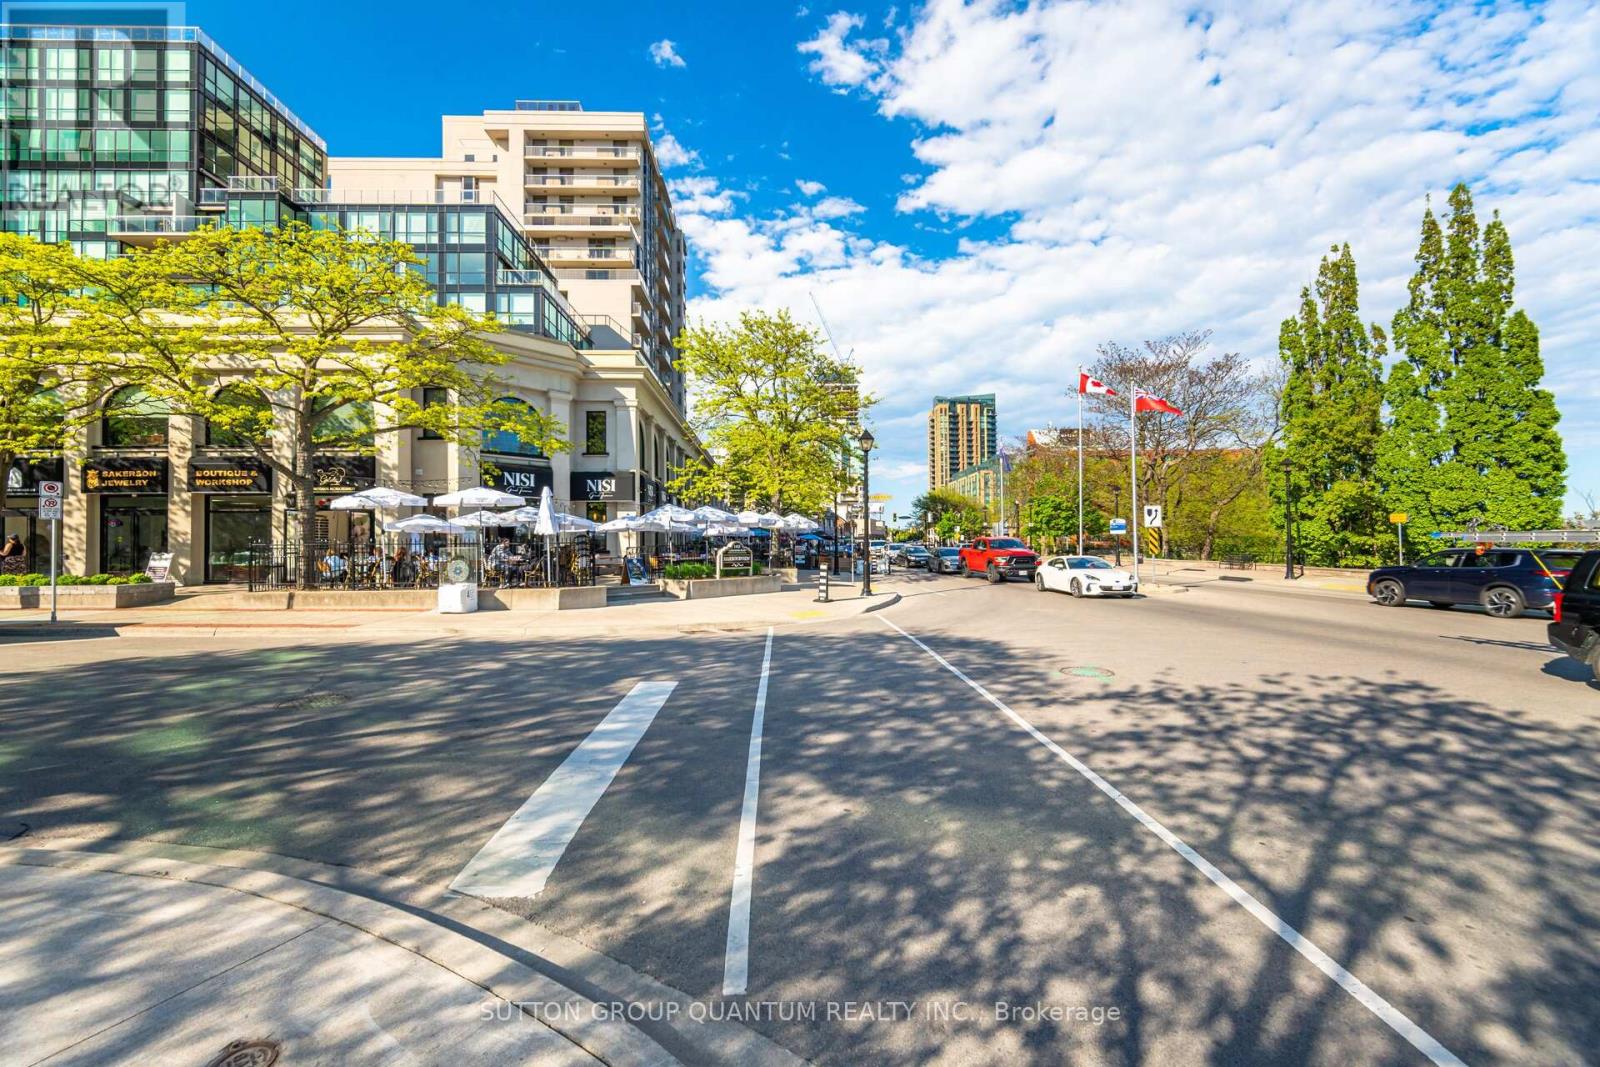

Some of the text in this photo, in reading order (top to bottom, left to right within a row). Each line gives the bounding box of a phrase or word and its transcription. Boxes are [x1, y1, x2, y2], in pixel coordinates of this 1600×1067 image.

[101, 479, 149, 487] JEWELRY
[503, 471, 535, 487] NISI
[586, 479, 616, 492] NISI
